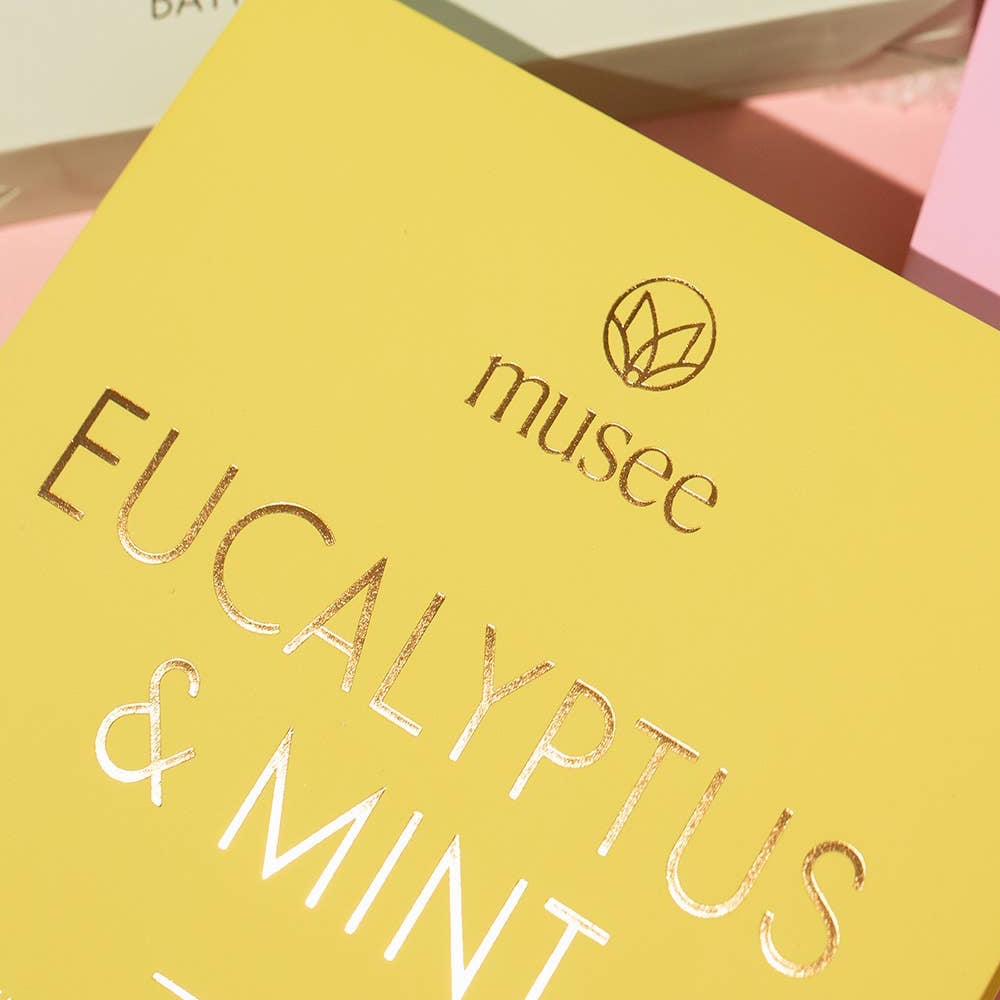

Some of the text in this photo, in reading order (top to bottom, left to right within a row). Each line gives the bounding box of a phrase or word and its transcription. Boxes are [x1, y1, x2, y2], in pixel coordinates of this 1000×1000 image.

[464, 353, 720, 534] musee
[37, 386, 866, 979] EUCALYPTUS
[94, 657, 610, 1000] & MINT
